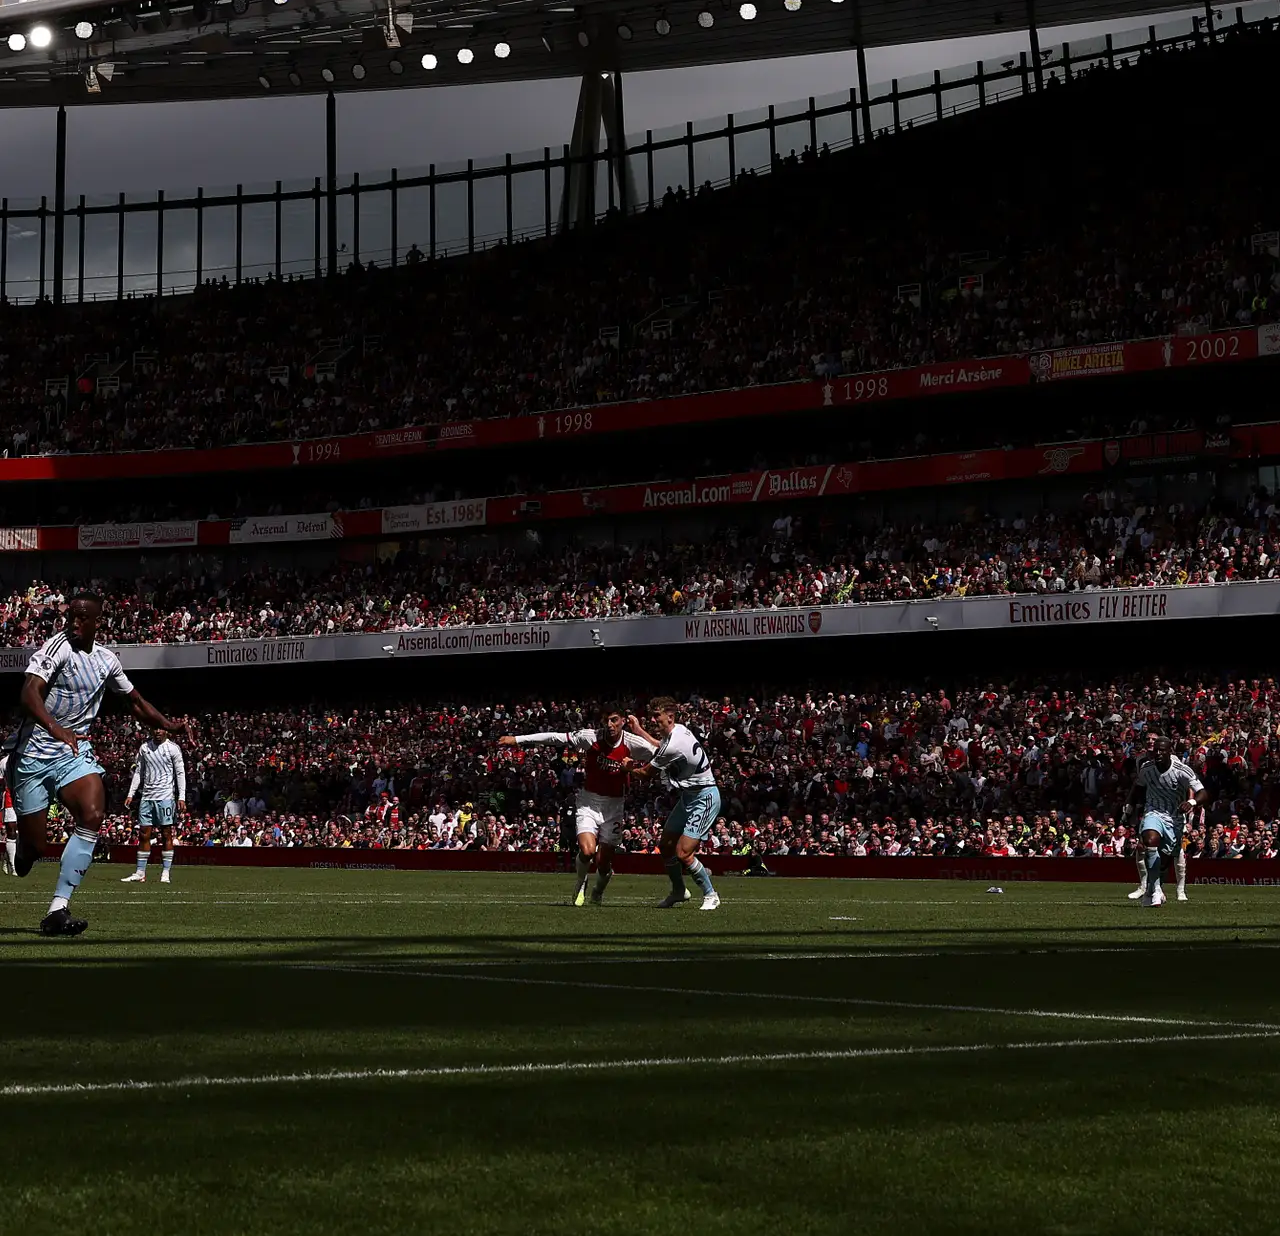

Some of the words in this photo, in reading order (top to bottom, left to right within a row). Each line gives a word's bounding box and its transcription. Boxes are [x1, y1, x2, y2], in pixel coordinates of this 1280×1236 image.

[1186, 336, 1240, 361] 2002
[1053, 354, 1083, 373] MIKEL
[1084, 351, 1124, 369] ARTETA
[843, 377, 888, 401] 1998
[919, 371, 955, 388] Merci
[956, 366, 1002, 383] Arsène
[374, 433, 403, 446] CENTRAL
[404, 431, 422, 443] PENN
[440, 424, 473, 438] GOONERS
[555, 412, 593, 434] 1998
[307, 442, 341, 463] 1994
[768, 471, 817, 496] Dallas
[642, 484, 731, 508] Arsenal.com
[94, 525, 140, 541] Arsenal
[250, 520, 290, 535] Arsenal
[296, 520, 328, 534] Detroit
[390, 519, 420, 530] Community
[1009, 598, 1091, 624] Emirates
[1098, 596, 1120, 619] FLY
[1122, 593, 1168, 617] BETTER
[685, 620, 702, 639] MY
[704, 617, 752, 637] ARSENAL
[753, 614, 805, 635] REWARDS
[397, 626, 551, 652] Arsenal.com/membership
[207, 645, 258, 665] Emirates
[262, 644, 276, 662] FLY
[278, 641, 305, 660] BETTER
[692, 741, 712, 774] 2
